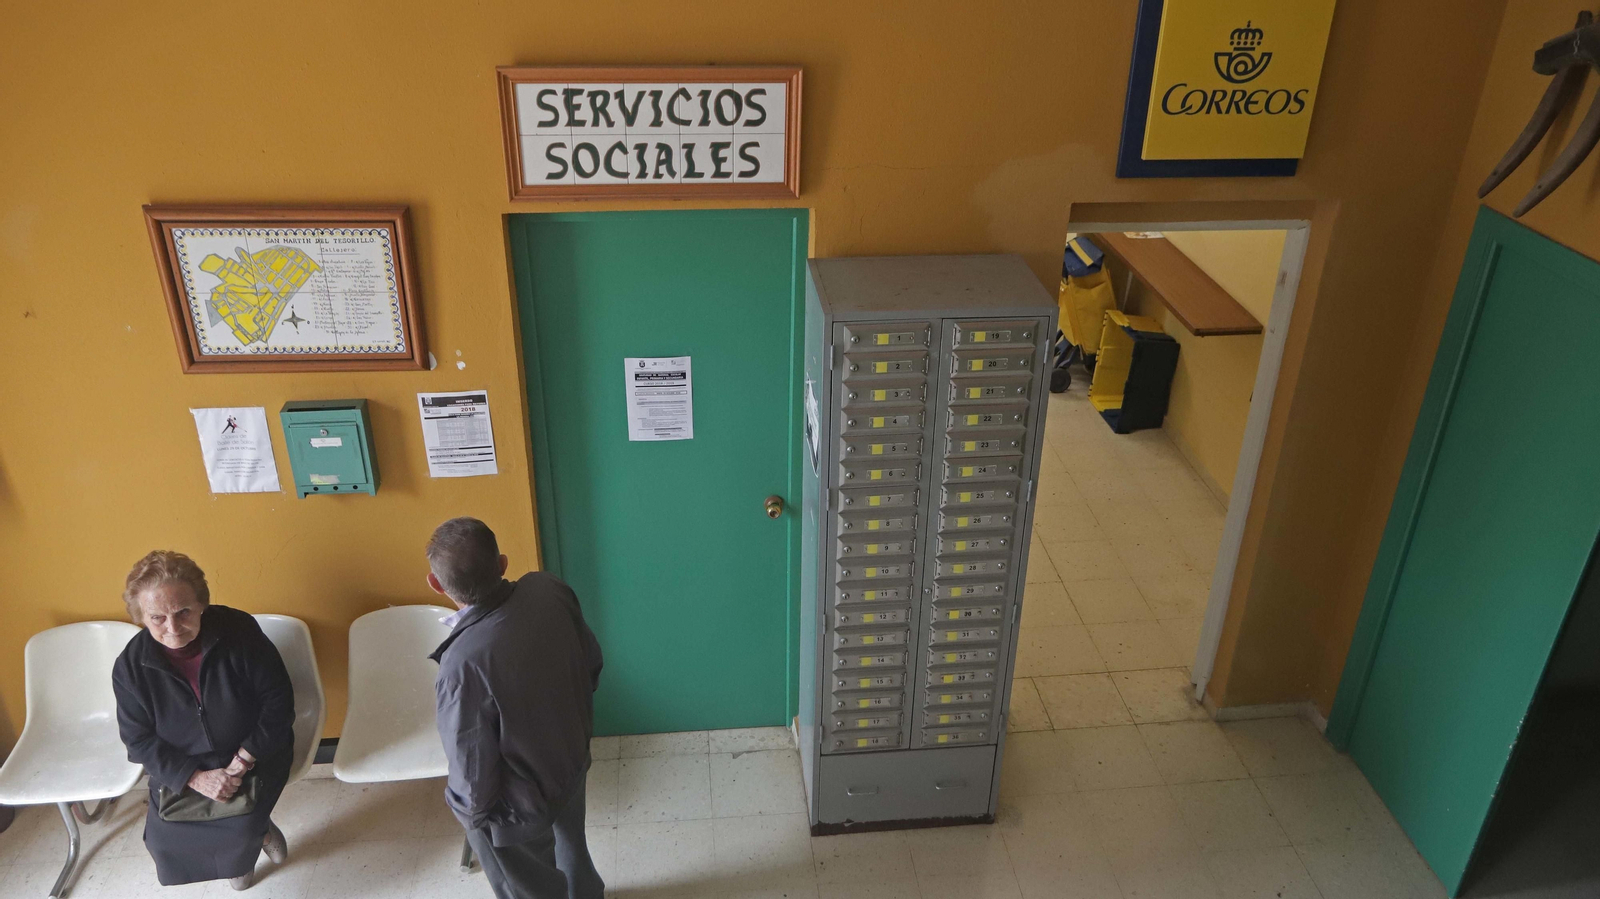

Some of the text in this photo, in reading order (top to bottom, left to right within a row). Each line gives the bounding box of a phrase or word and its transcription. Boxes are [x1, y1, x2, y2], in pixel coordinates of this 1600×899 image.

[536, 87, 767, 128] SERVICIOS
[1161, 83, 1309, 115] CORREOS
[545, 140, 761, 180] SOCIALES
